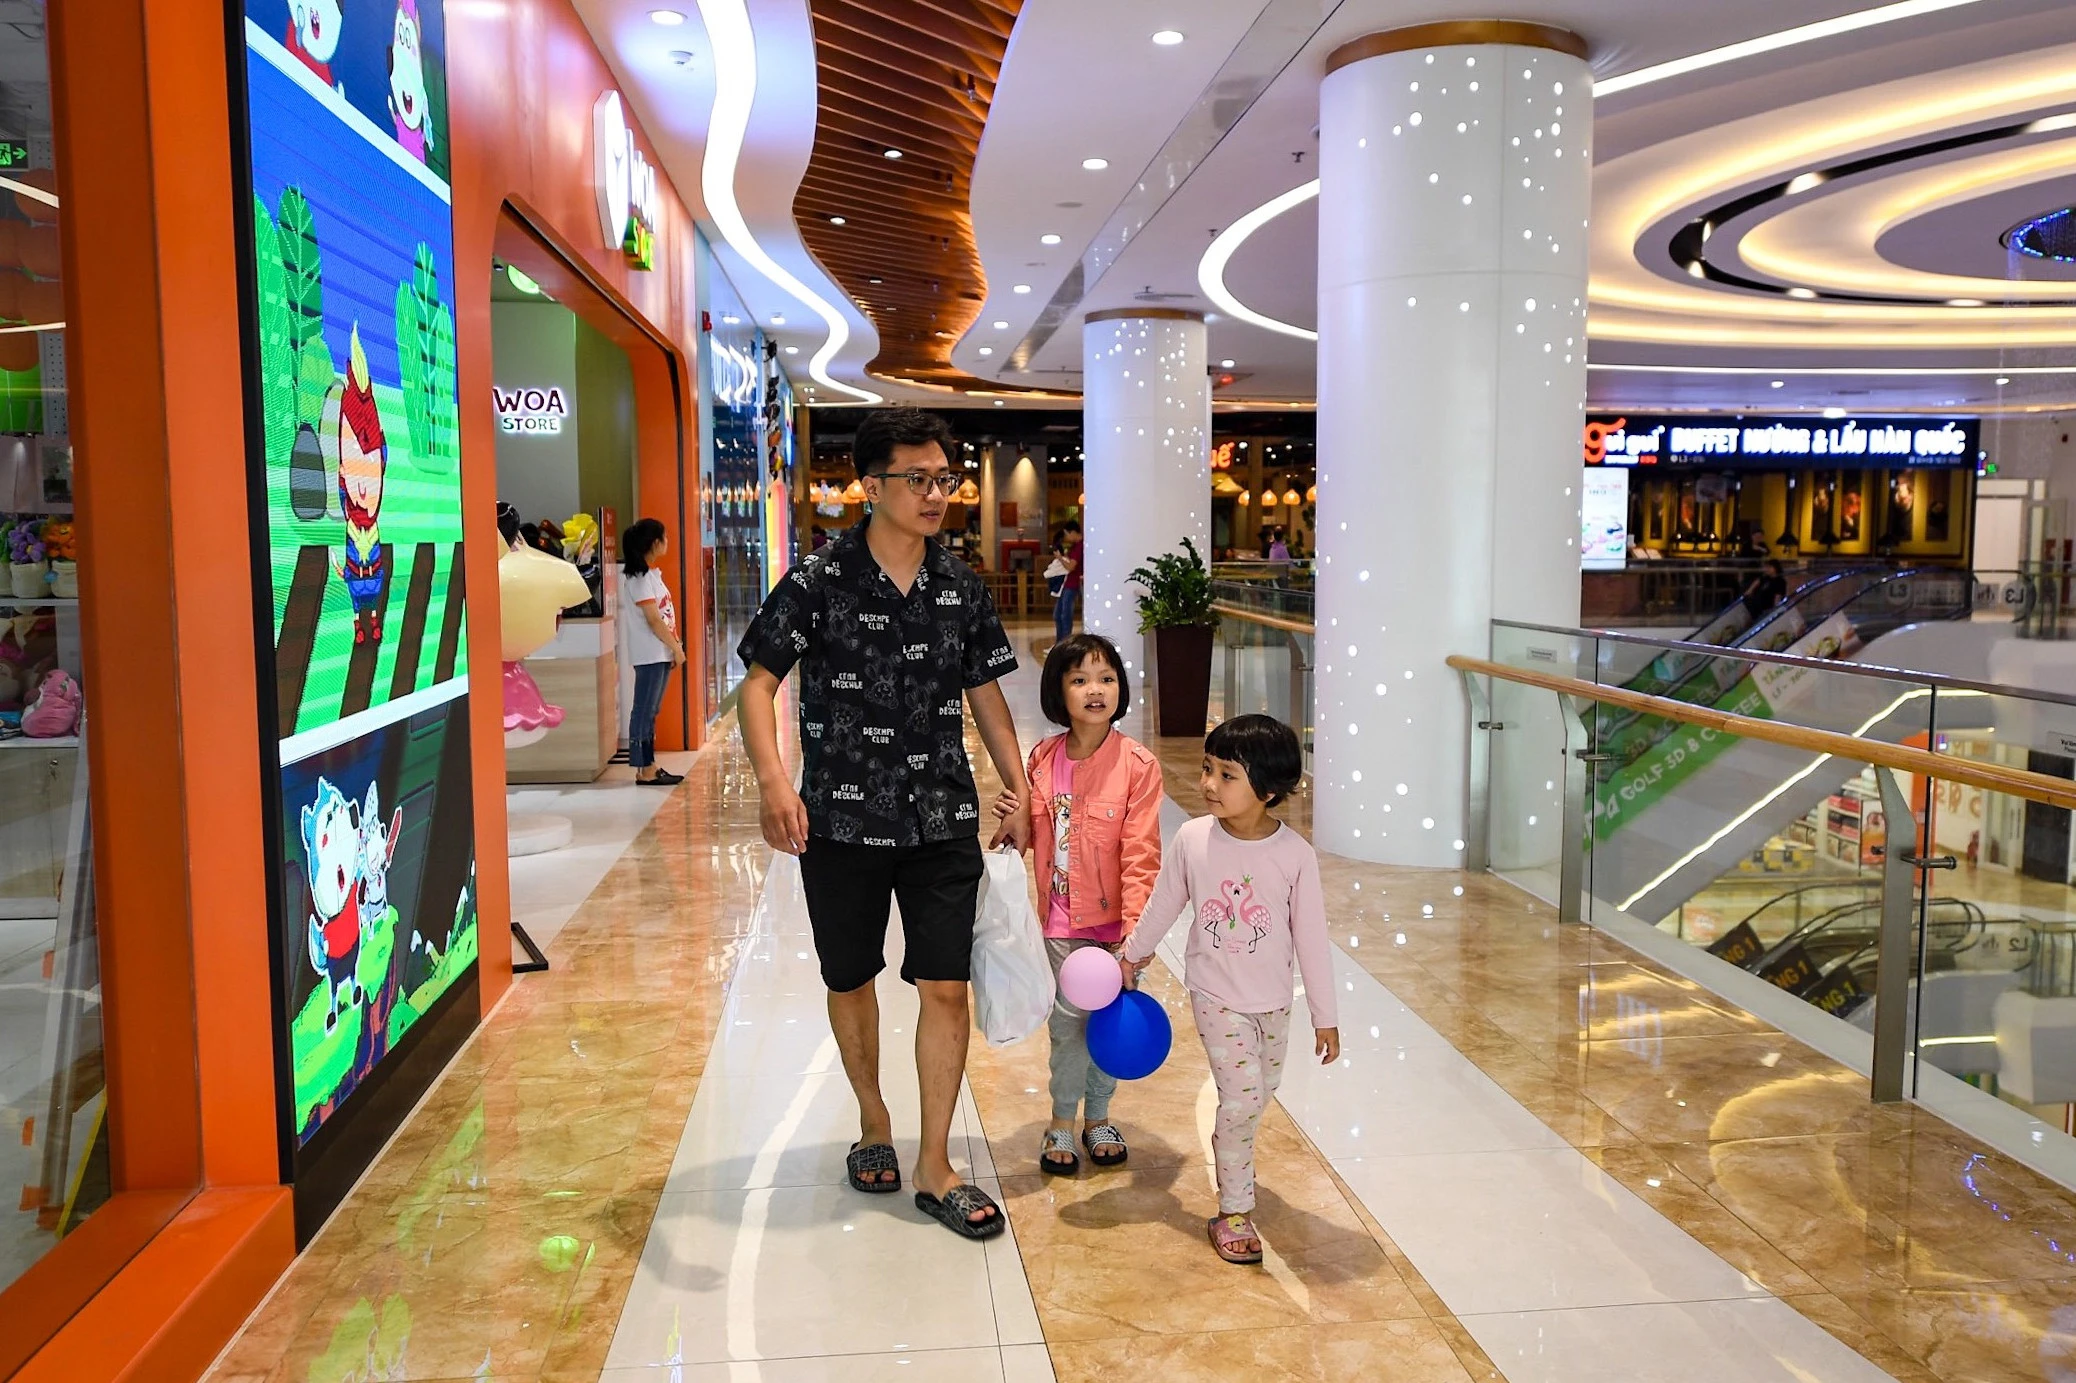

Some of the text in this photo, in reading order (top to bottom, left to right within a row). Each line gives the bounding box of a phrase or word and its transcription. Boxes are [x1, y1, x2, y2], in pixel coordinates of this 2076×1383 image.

[492, 387, 565, 414] WOA
[503, 417, 558, 431] STORE
[1671, 427, 1740, 454] BUFFET
[1812, 429, 1829, 454] &
[867, 622, 885, 631] CLUB
[871, 736, 890, 744] CLUB
[1620, 762, 1665, 801] GOLF
[1667, 749, 1686, 770] 3D
[1687, 738, 1700, 752] &
[1745, 937, 1756, 952] 1
[1798, 959, 1809, 976] 1
[1843, 981, 1856, 997] 1
